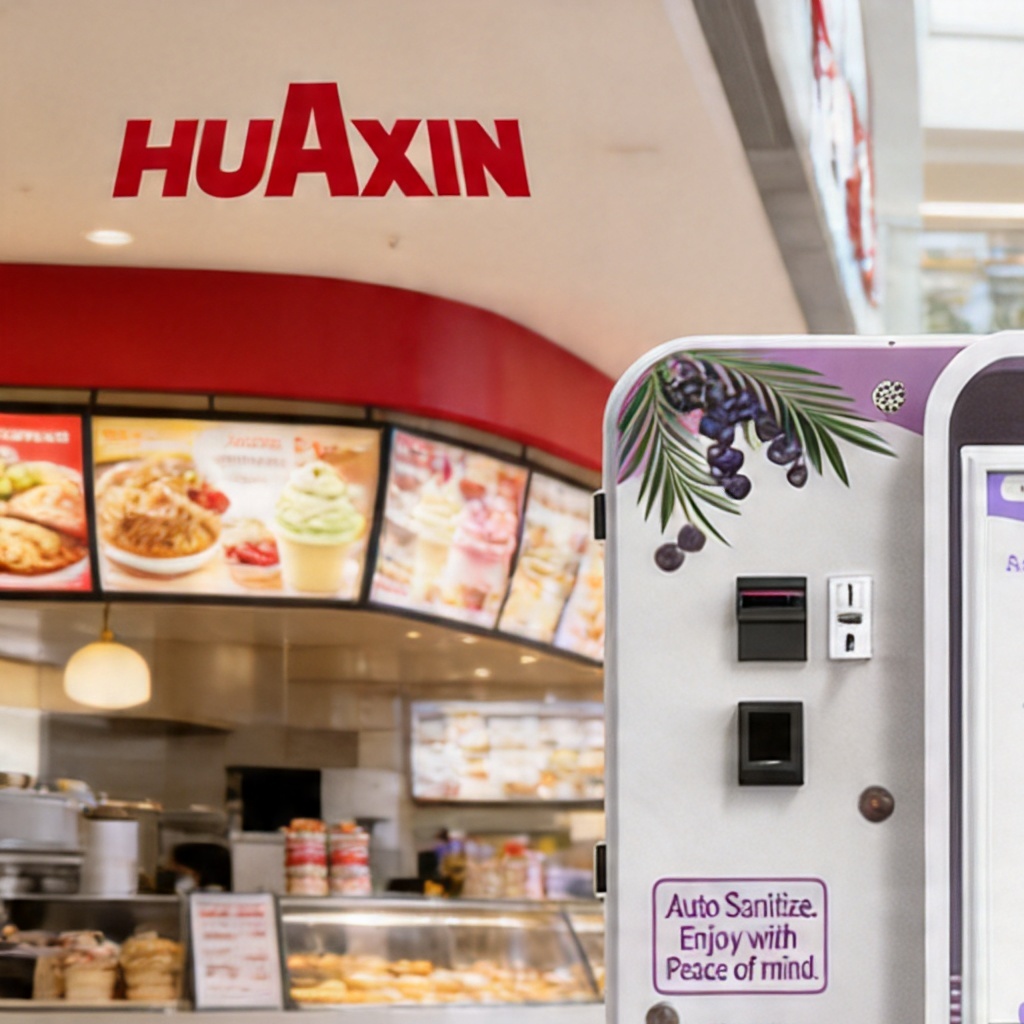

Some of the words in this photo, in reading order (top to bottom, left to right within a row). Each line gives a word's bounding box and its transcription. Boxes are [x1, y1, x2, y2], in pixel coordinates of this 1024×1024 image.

[665, 893, 720, 919] Auto
[680, 924, 742, 957] Enjoy
[747, 923, 797, 950] with
[666, 956, 729, 981] Peace
[733, 955, 757, 981] of
